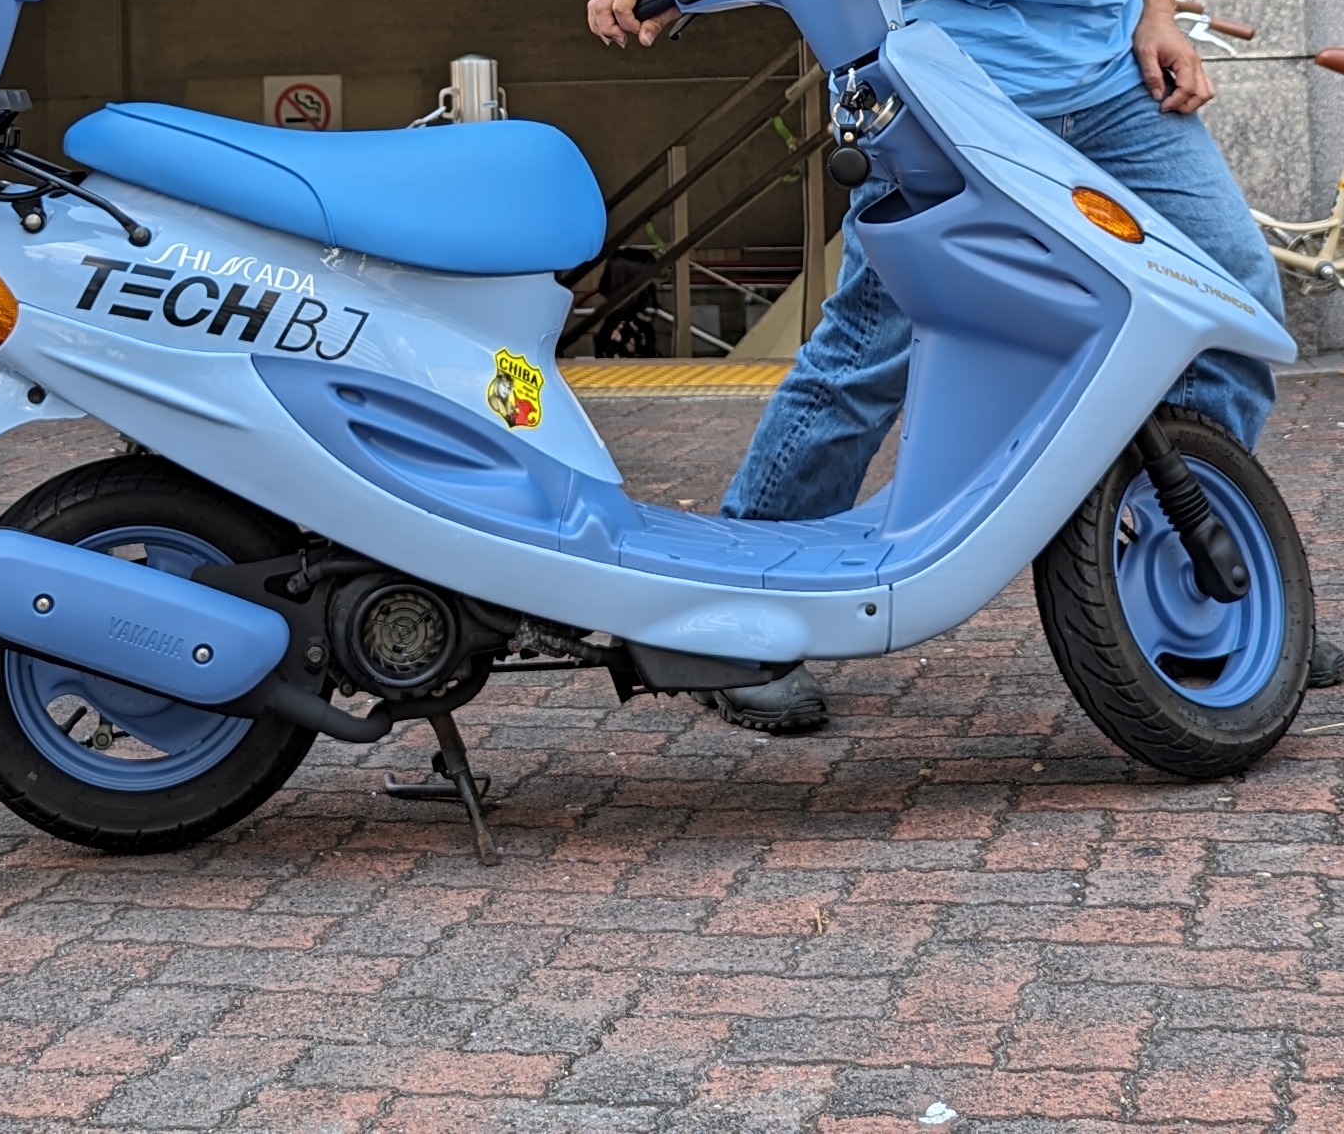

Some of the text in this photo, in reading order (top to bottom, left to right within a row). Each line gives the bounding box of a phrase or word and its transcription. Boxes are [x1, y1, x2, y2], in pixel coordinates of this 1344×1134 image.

[75, 254, 371, 361] TECH BJ
[499, 357, 539, 388] CHIBA
[107, 616, 185, 660] YAMAHA
